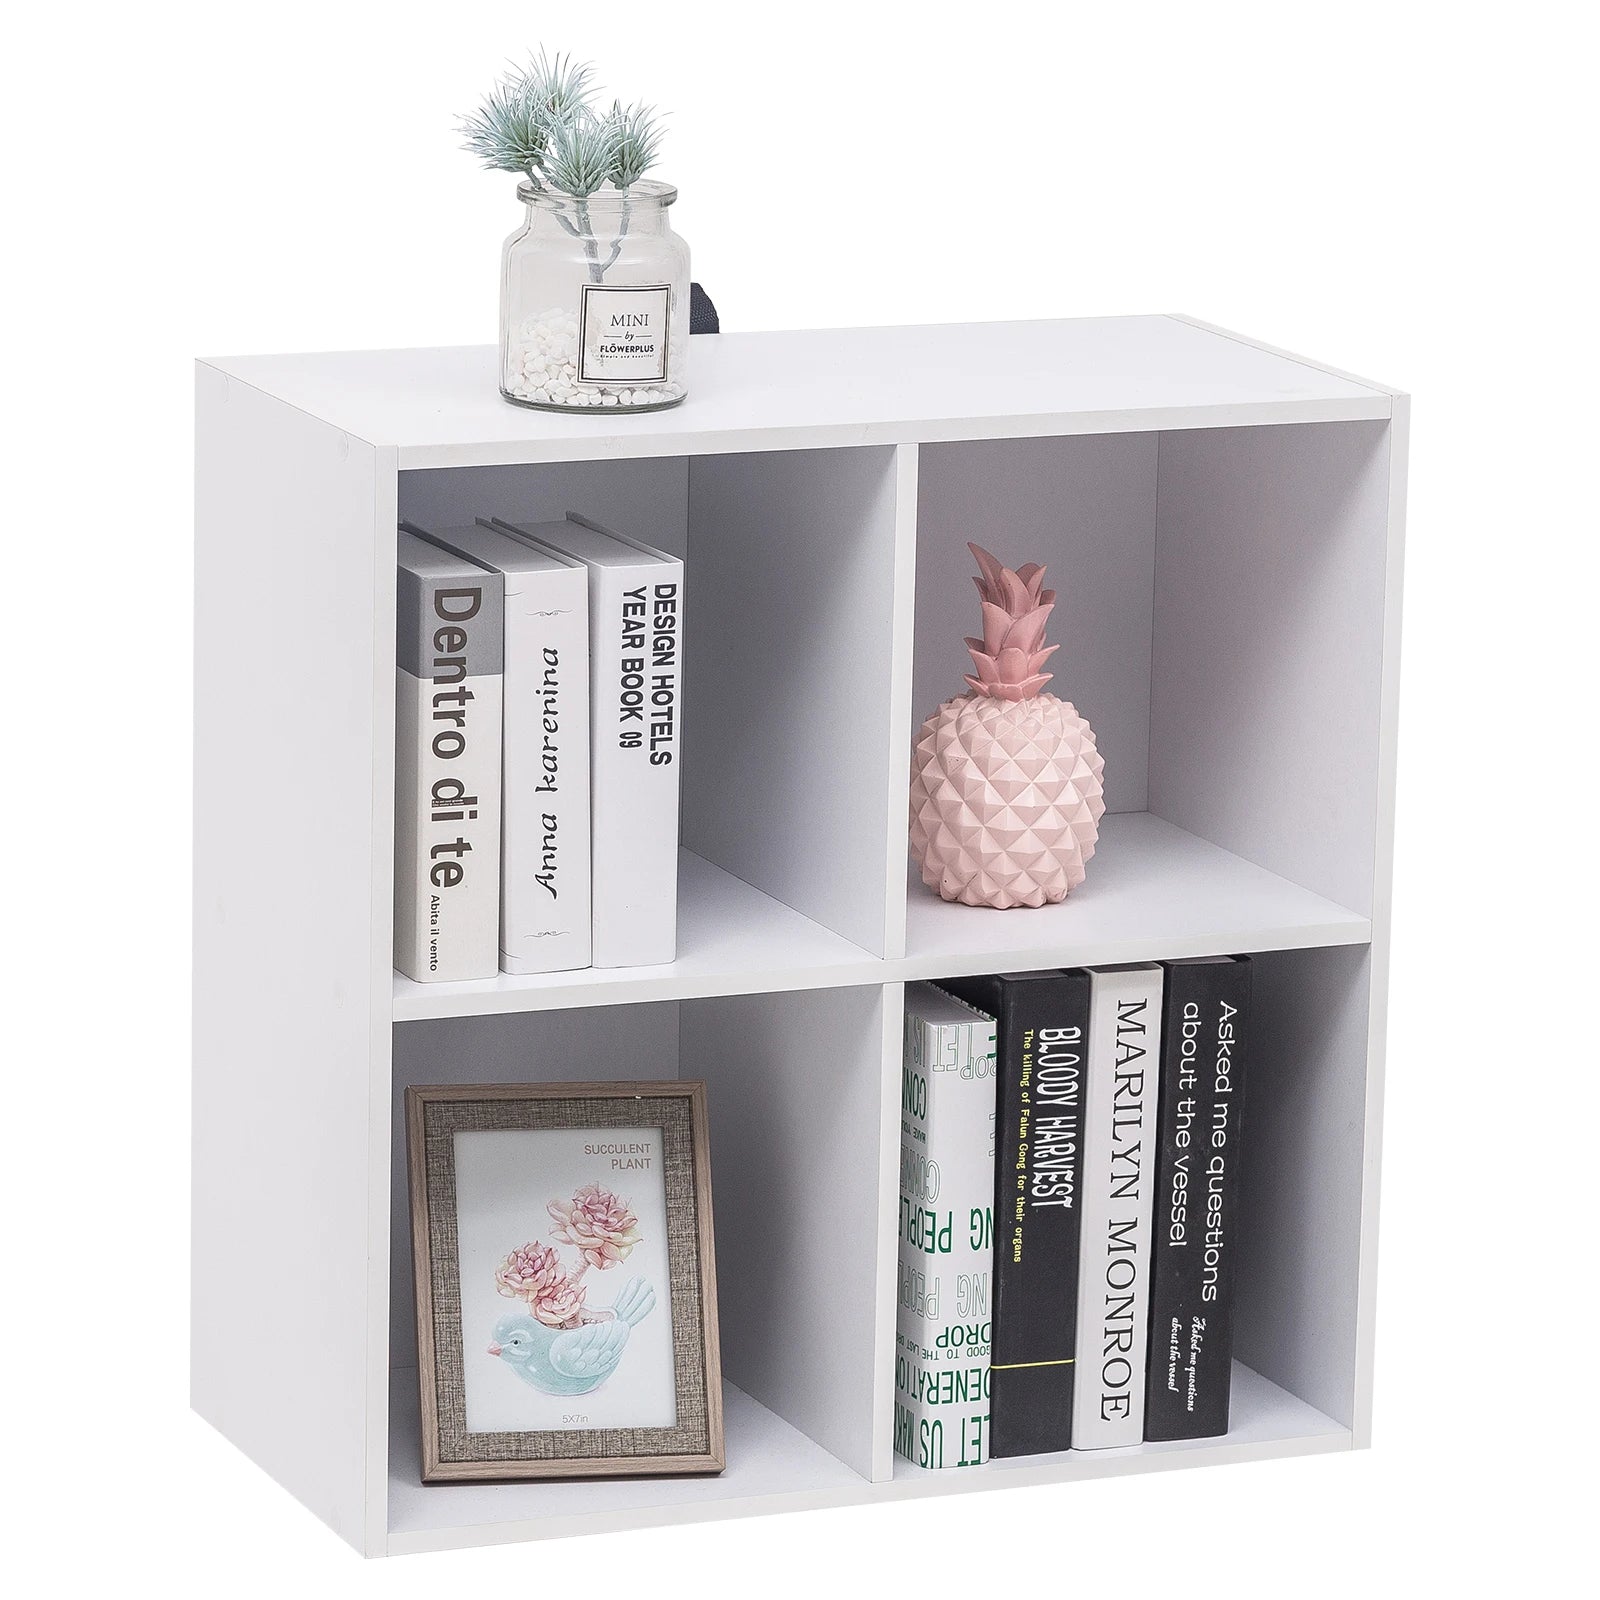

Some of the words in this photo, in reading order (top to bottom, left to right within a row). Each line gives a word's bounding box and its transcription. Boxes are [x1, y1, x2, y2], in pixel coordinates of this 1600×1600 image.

[610, 314, 649, 327] MINI
[624, 331, 635, 341] by
[621, 585, 647, 650] YEAR
[652, 583, 678, 667] DESIGN
[432, 587, 482, 760] Dentro
[619, 657, 645, 723] BOOK
[535, 647, 559, 793] karenina
[649, 674, 675, 767] HOTELS
[618, 731, 643, 748] 09
[431, 778, 478, 822] di
[430, 837, 473, 888] te
[534, 813, 558, 900] Anna
[430, 894, 440, 926] Abita
[429, 928, 440, 936] il
[429, 938, 439, 972] vento
[1023, 1029, 1034, 1049] The
[1179, 1001, 1202, 1090] about
[1214, 1000, 1238, 1093] Asked
[1019, 1054, 1033, 1088] killing
[1036, 1026, 1081, 1106] BLOODY
[1021, 1092, 1031, 1104] of
[1105, 997, 1148, 1202] MARILYN
[1019, 1109, 1030, 1139] Falun
[1175, 1096, 1197, 1148] the
[1211, 1102, 1229, 1148] me
[584, 1143, 651, 1157] SUCCULENT
[611, 1158, 652, 1170] PLANT
[1015, 1143, 1029, 1170] Gong
[1031, 1115, 1077, 1208] HARVEST
[1017, 1174, 1027, 1191] for
[1168, 1154, 1190, 1247] vessel
[1015, 1196, 1026, 1222] their
[1012, 1227, 1023, 1263] organs
[1201, 1155, 1226, 1302] questions
[1099, 1217, 1138, 1422] MONROE
[1170, 1317, 1183, 1345] about
[1190, 1316, 1207, 1354] Asked
[906, 1338, 920, 1356] LAST
[921, 1348, 940, 1361] THE
[946, 1348, 960, 1360] TO
[1169, 1345, 1181, 1361] the
[1190, 1351, 1197, 1365] me
[1167, 1362, 1179, 1393] vessel
[1184, 1366, 1198, 1412] questions
[919, 1418, 944, 1469] US
